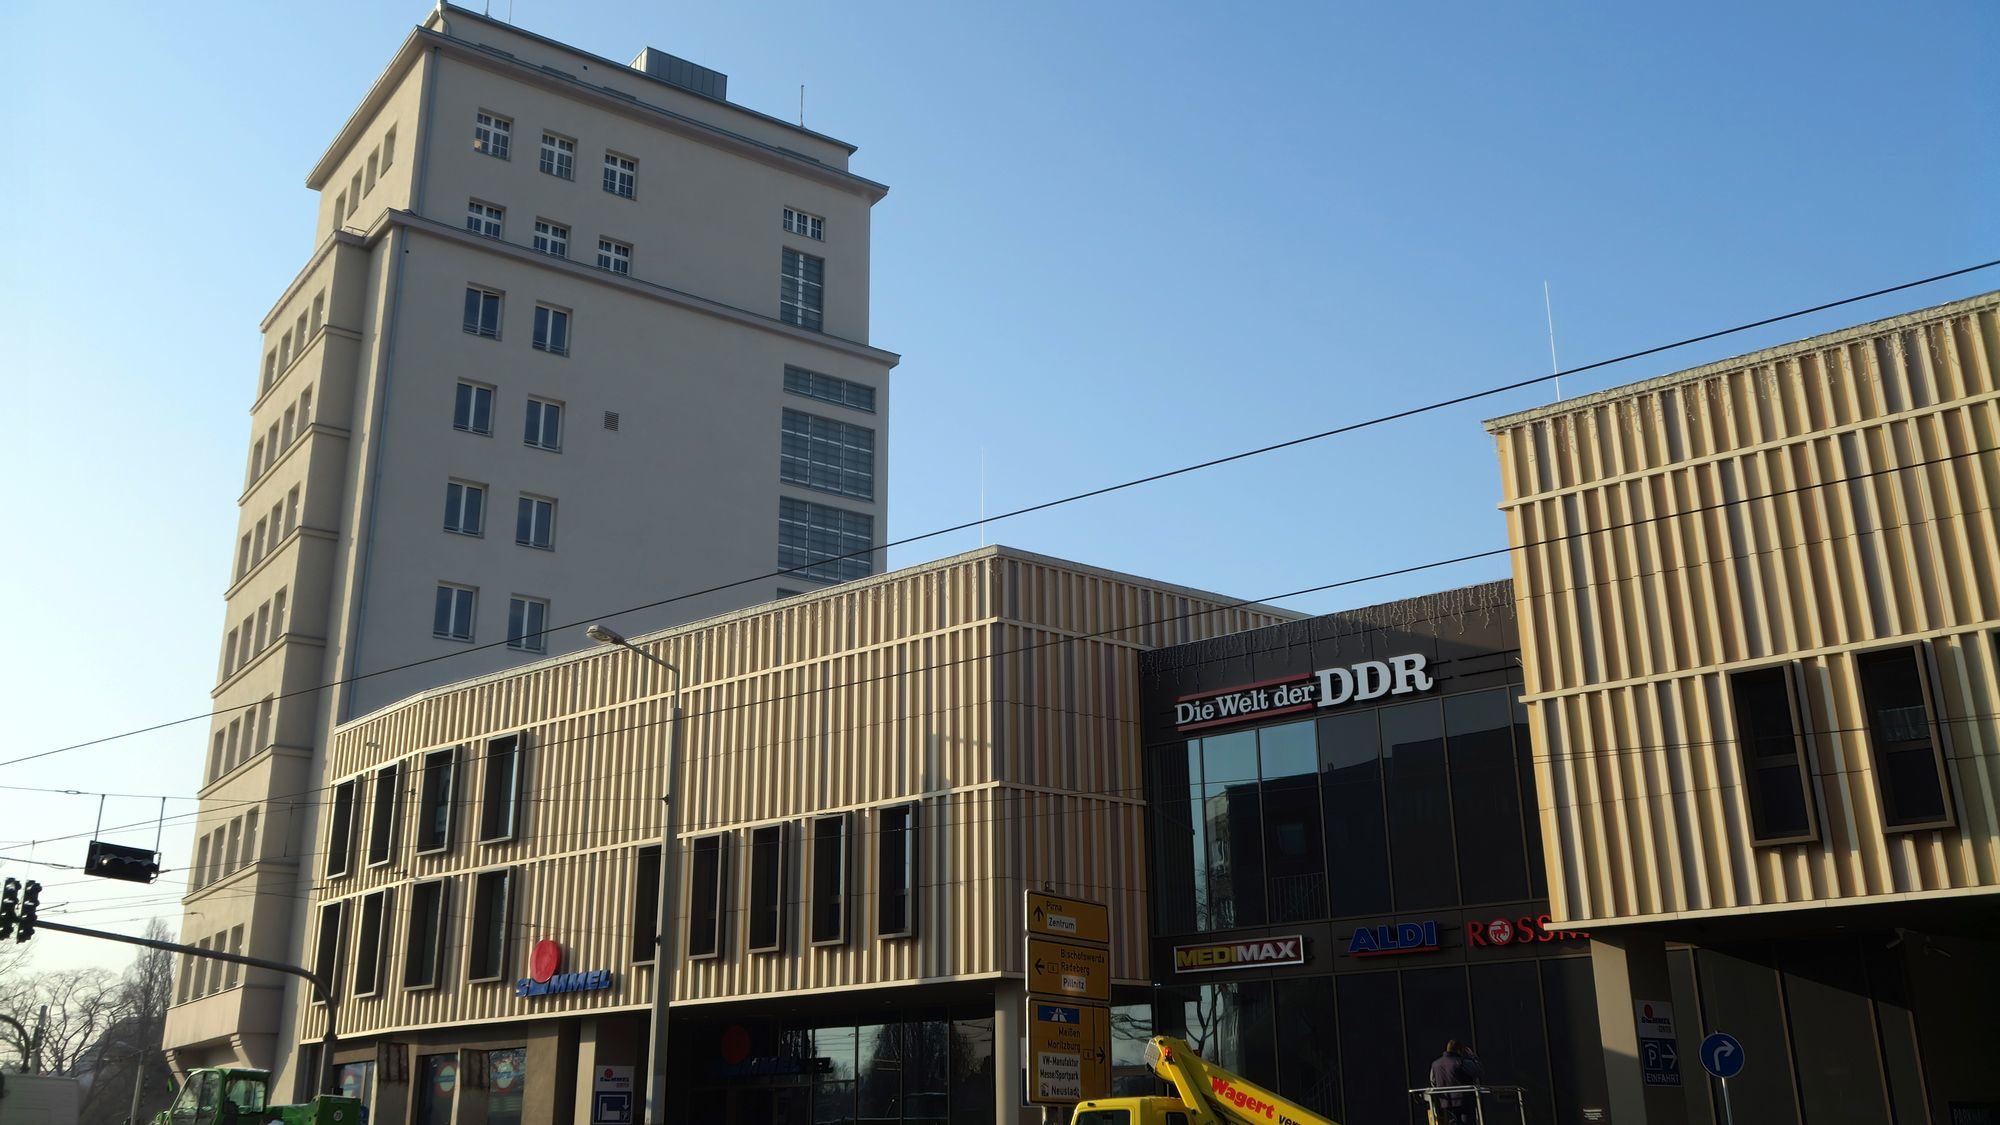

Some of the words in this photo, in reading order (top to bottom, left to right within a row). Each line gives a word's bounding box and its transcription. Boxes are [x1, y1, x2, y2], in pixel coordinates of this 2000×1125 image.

[1175, 700, 1215, 725] Die
[1216, 688, 1269, 718] Welt
[1273, 684, 1315, 708] der
[1314, 653, 1434, 708] DDR
[1046, 901, 1063, 912] Pirna
[1048, 917, 1075, 930] Zentrum
[1466, 913, 1591, 947] ROSS
[1349, 920, 1438, 953] ALDI
[1176, 940, 1296, 968] MEDIMAX
[1061, 961, 1090, 976] Radeberg
[1063, 978, 1085, 990] Pillnitz
[1058, 1027, 1081, 1038] Meißen
[1047, 1039, 1081, 1053] Moritzburg
[1042, 1055, 1079, 1067] VW-Manufaktur
[1646, 1073, 1680, 1083] EINFAHRT
[1211, 1075, 1274, 1119] Wagert
